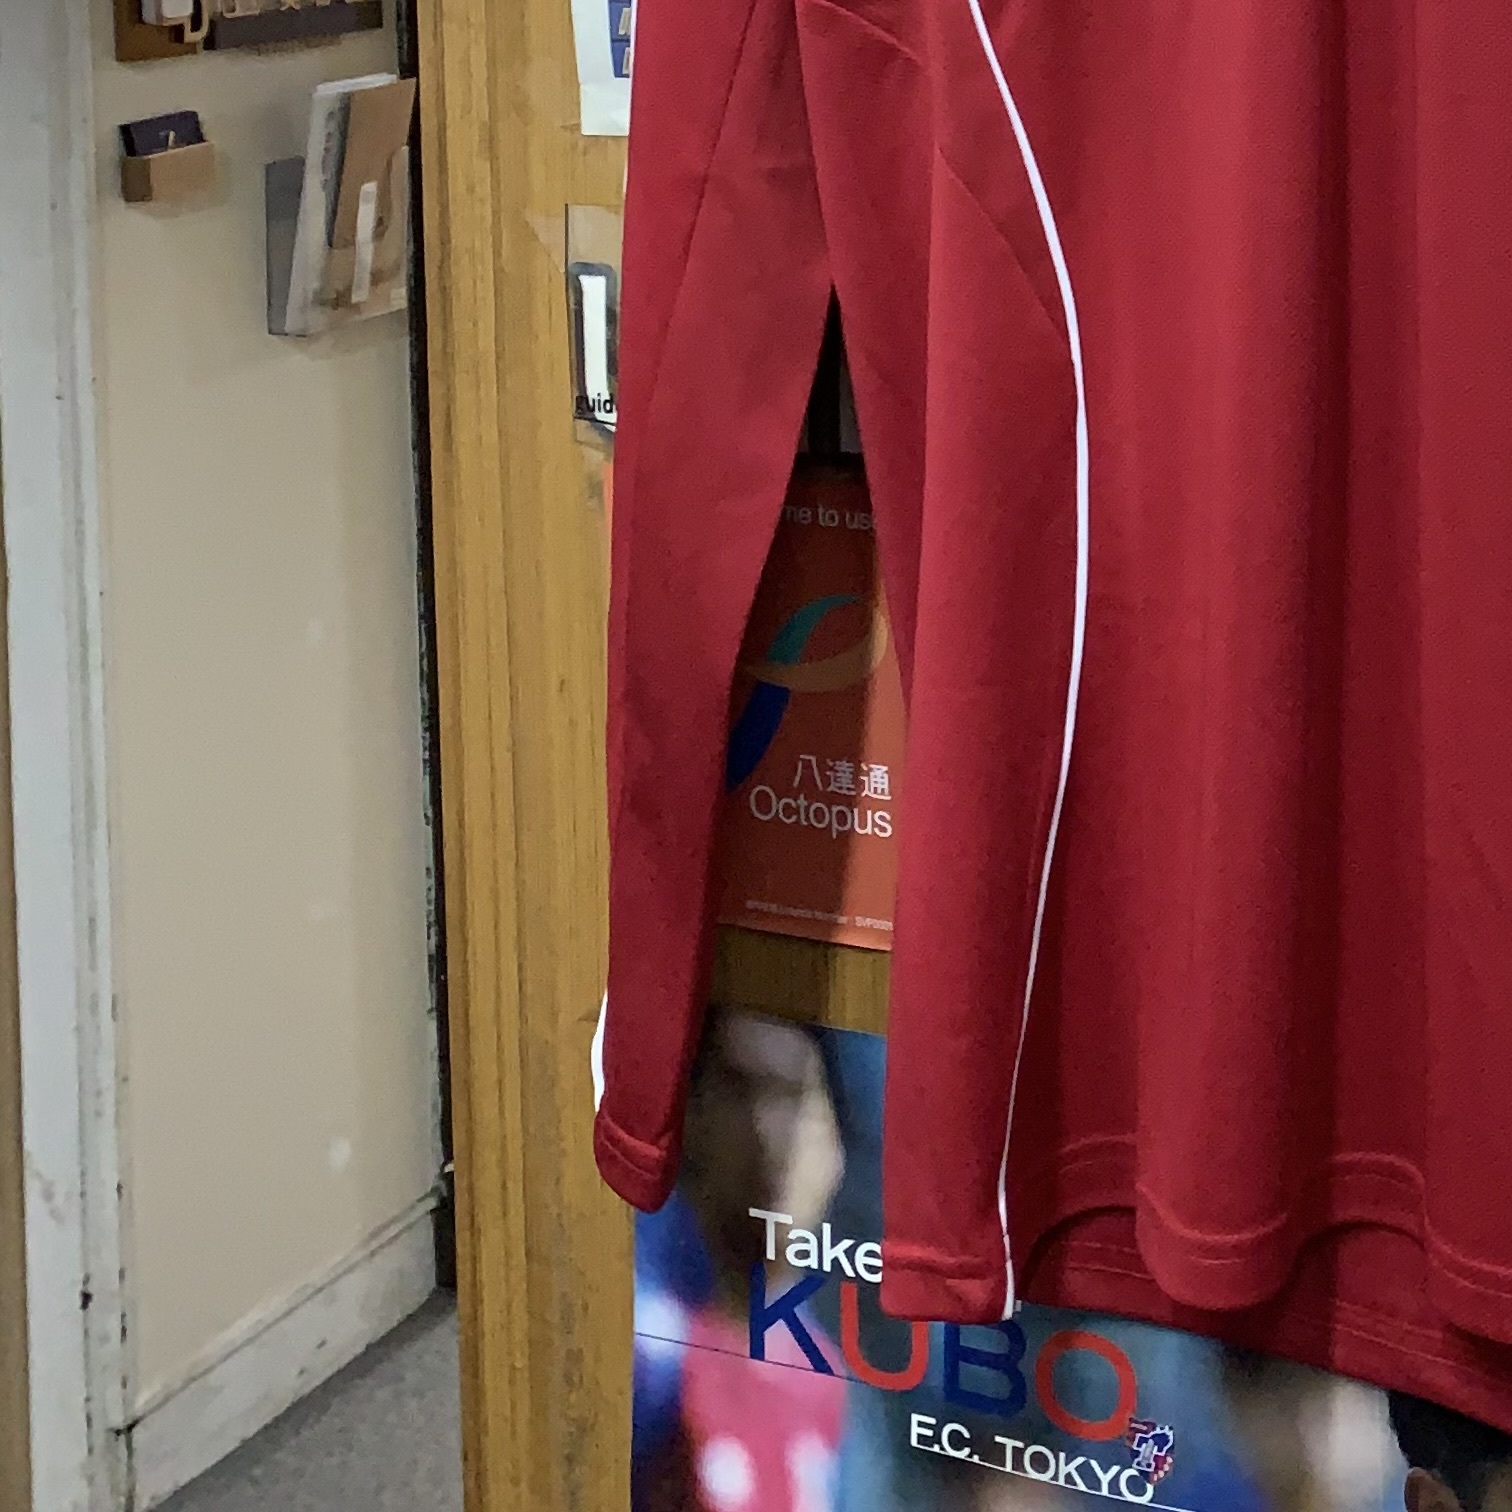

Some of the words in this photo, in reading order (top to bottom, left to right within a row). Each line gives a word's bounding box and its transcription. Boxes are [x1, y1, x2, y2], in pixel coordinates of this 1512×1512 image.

[817, 503, 840, 527] to
[792, 754, 892, 800] 八達通
[749, 784, 893, 839] Octopus
[749, 1261, 1138, 1441] KUBO
[994, 1435, 1154, 1504] TOKYO
